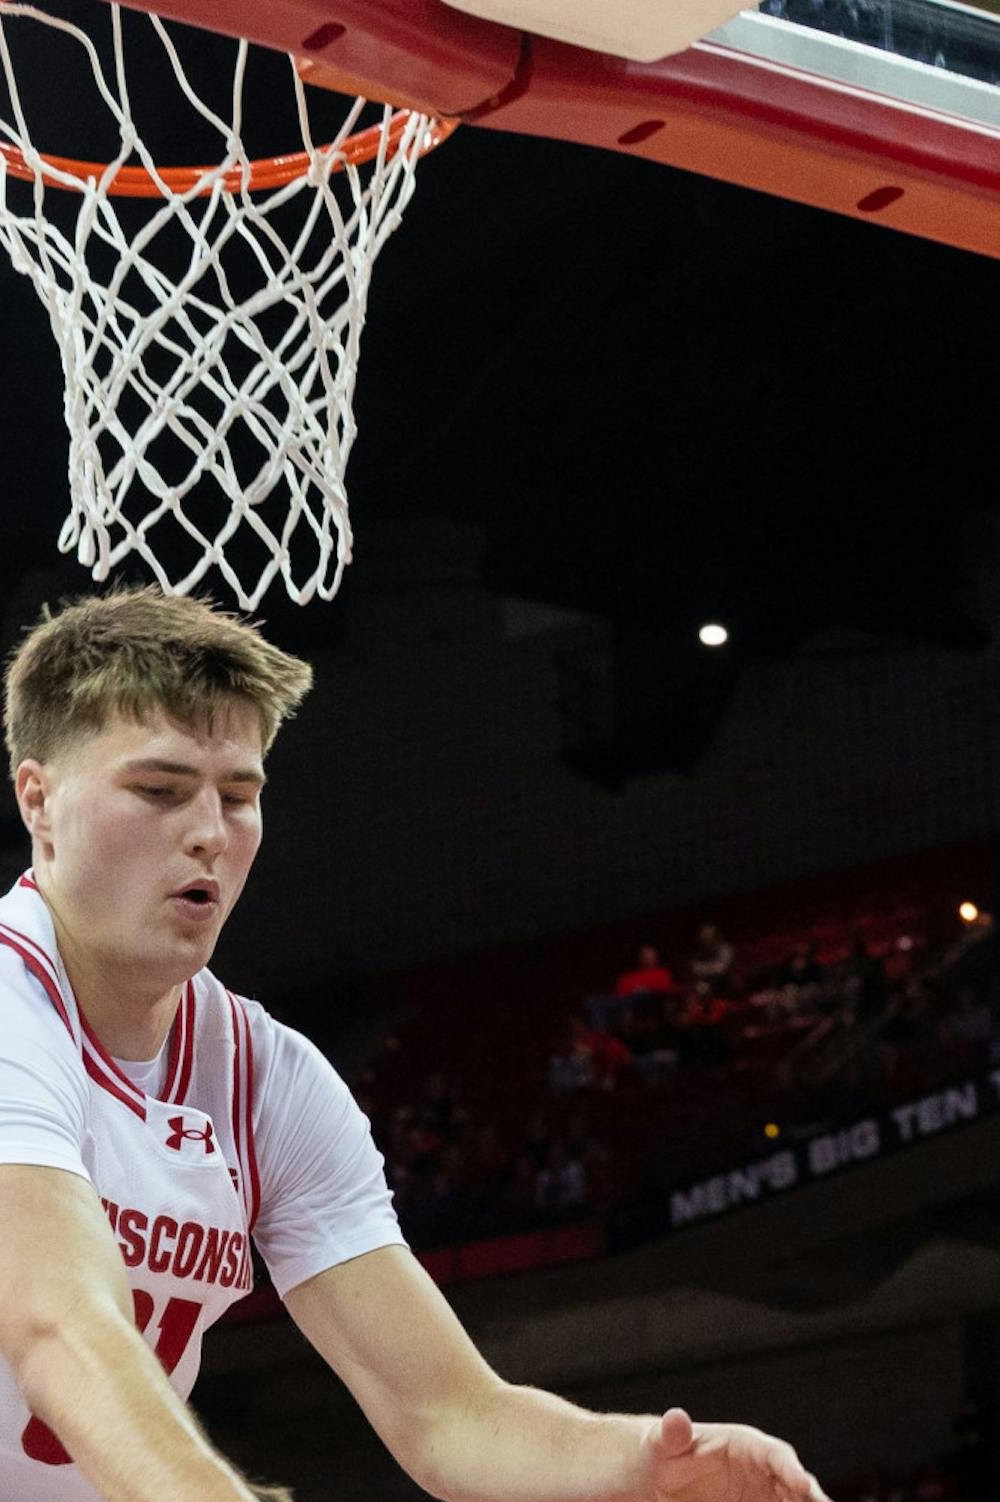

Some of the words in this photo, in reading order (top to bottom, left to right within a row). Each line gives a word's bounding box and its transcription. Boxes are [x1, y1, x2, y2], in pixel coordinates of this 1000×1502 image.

[670, 1150, 796, 1226] MEN'S
[808, 1119, 880, 1174] BIG
[890, 1082, 977, 1140] TEN
[101, 1197, 251, 1291] SCONSI
